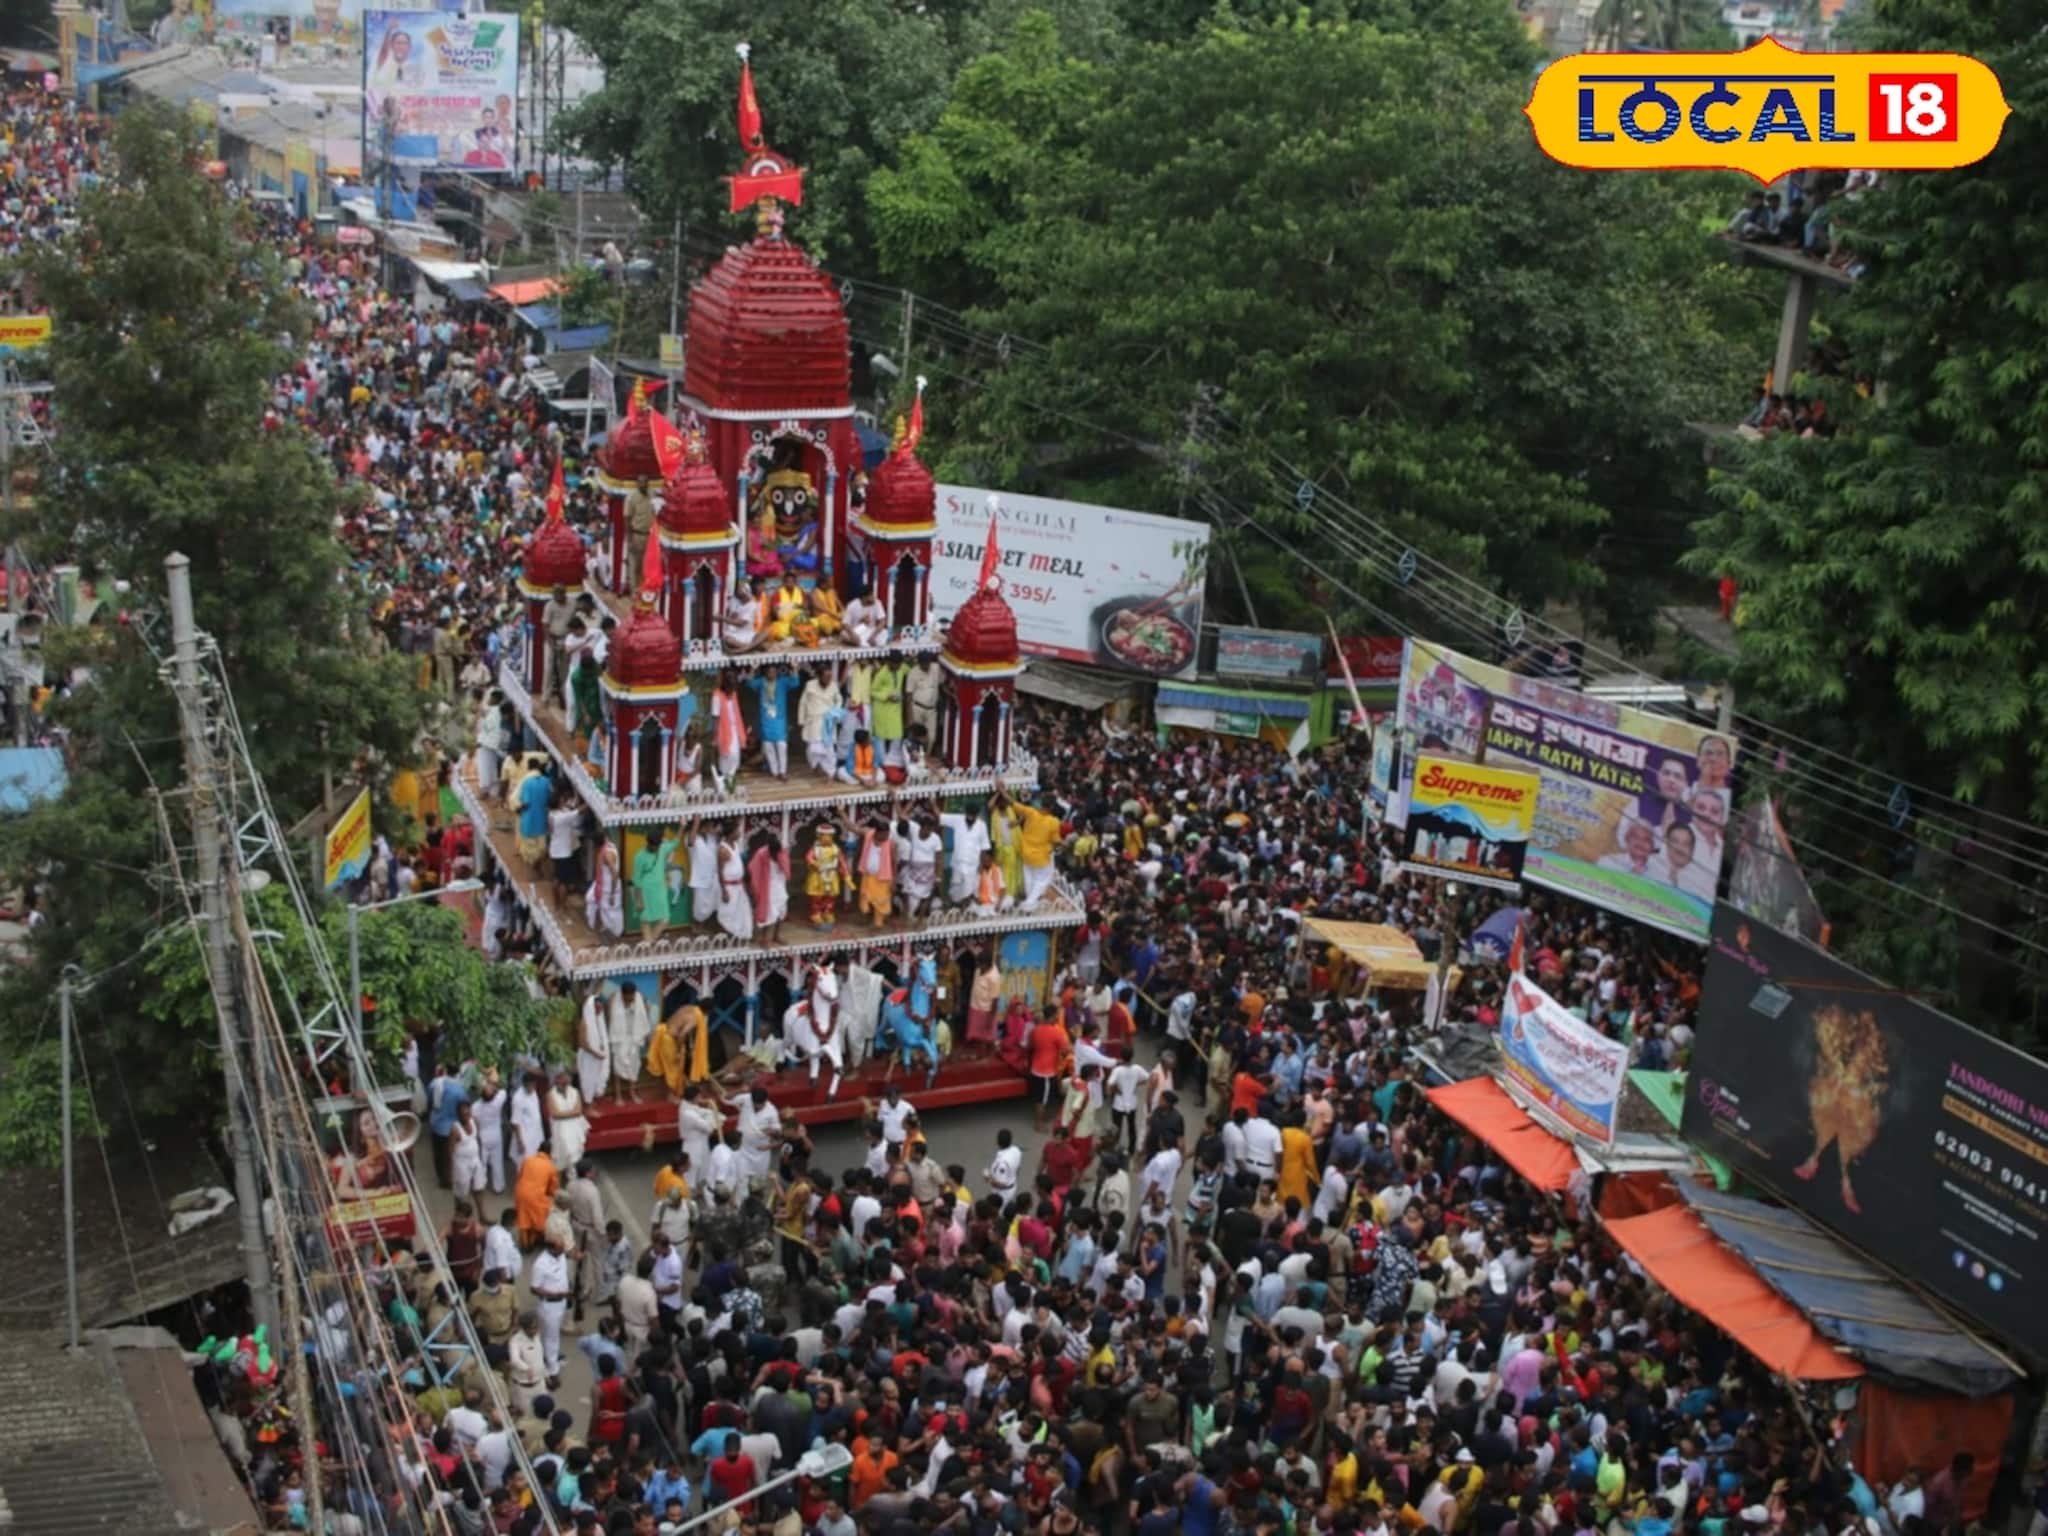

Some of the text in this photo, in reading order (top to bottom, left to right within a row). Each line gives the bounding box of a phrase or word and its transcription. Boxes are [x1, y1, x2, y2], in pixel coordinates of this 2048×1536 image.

[1419, 765, 1525, 803] Supreme
[1538, 742, 1585, 773] RATH
[1588, 758, 1646, 794] YATRA
[1934, 1130, 1993, 1173] 62903
[2001, 1167, 2048, 1204] 9941
